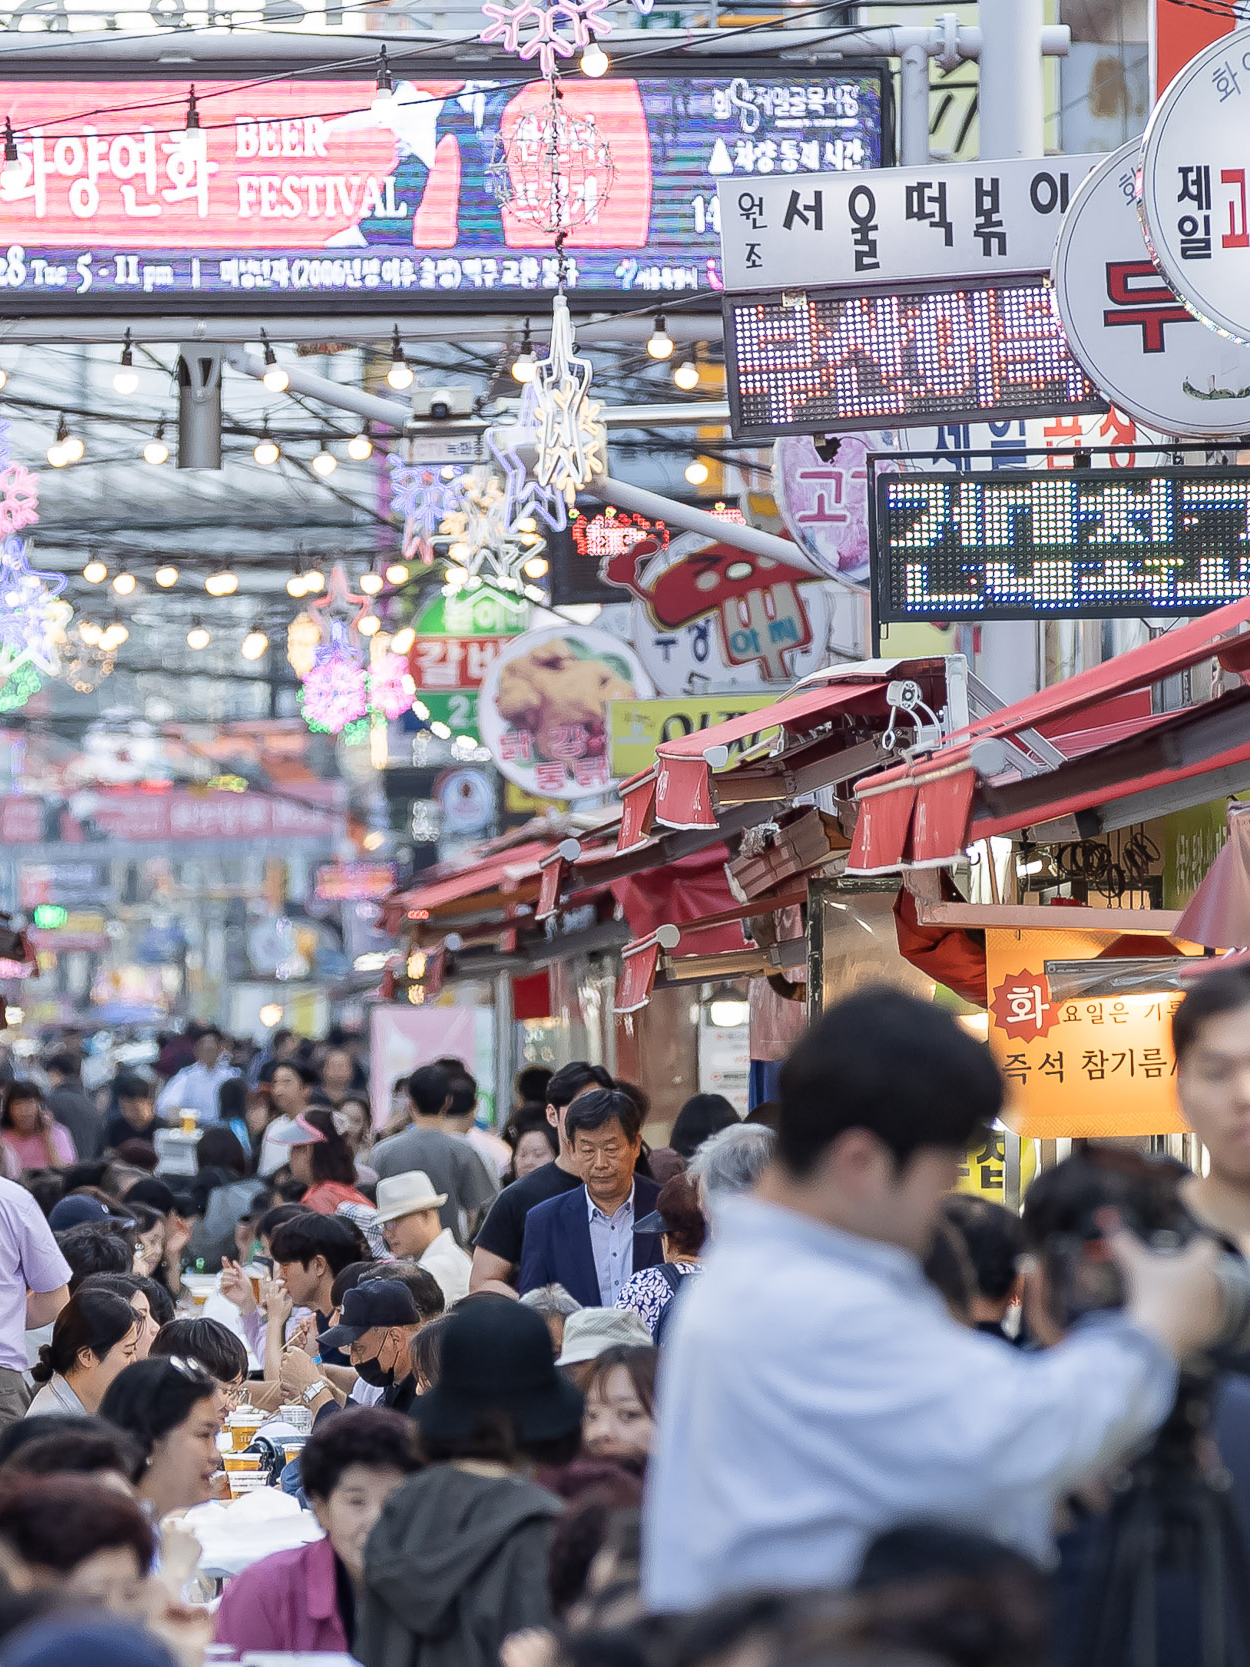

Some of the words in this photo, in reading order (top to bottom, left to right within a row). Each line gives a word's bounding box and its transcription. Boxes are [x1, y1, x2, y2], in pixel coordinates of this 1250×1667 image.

[235, 115, 329, 158] BEER
[236, 174, 409, 219] FESTIVAL
[1177, 165, 1212, 260] 제일
[782, 171, 1069, 273] 서울떡볶이
[1001, 1050, 1066, 1085] 즉석
